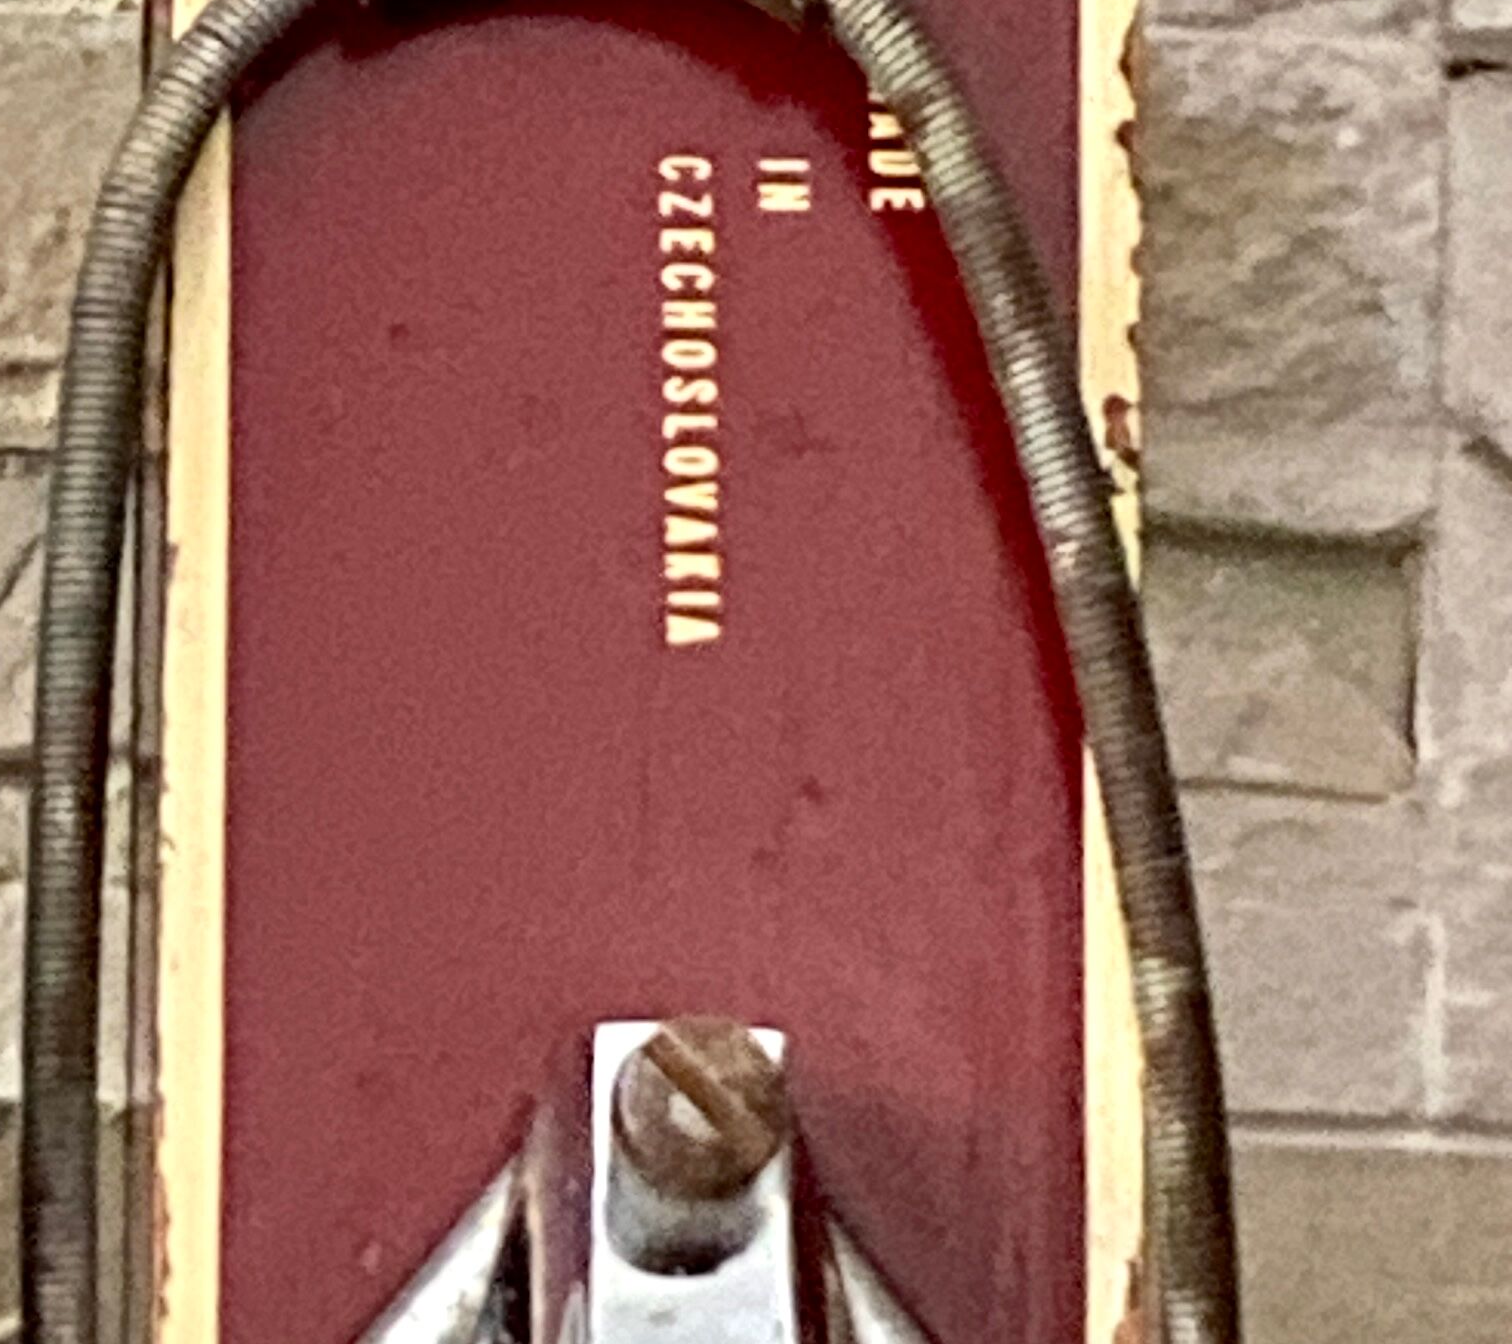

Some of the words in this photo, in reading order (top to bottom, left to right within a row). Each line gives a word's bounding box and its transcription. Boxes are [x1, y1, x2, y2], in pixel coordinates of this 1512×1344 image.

[758, 158, 810, 211] IN
[868, 90, 926, 211] ADE
[660, 155, 720, 645] CZECHOSLOVAKIA
